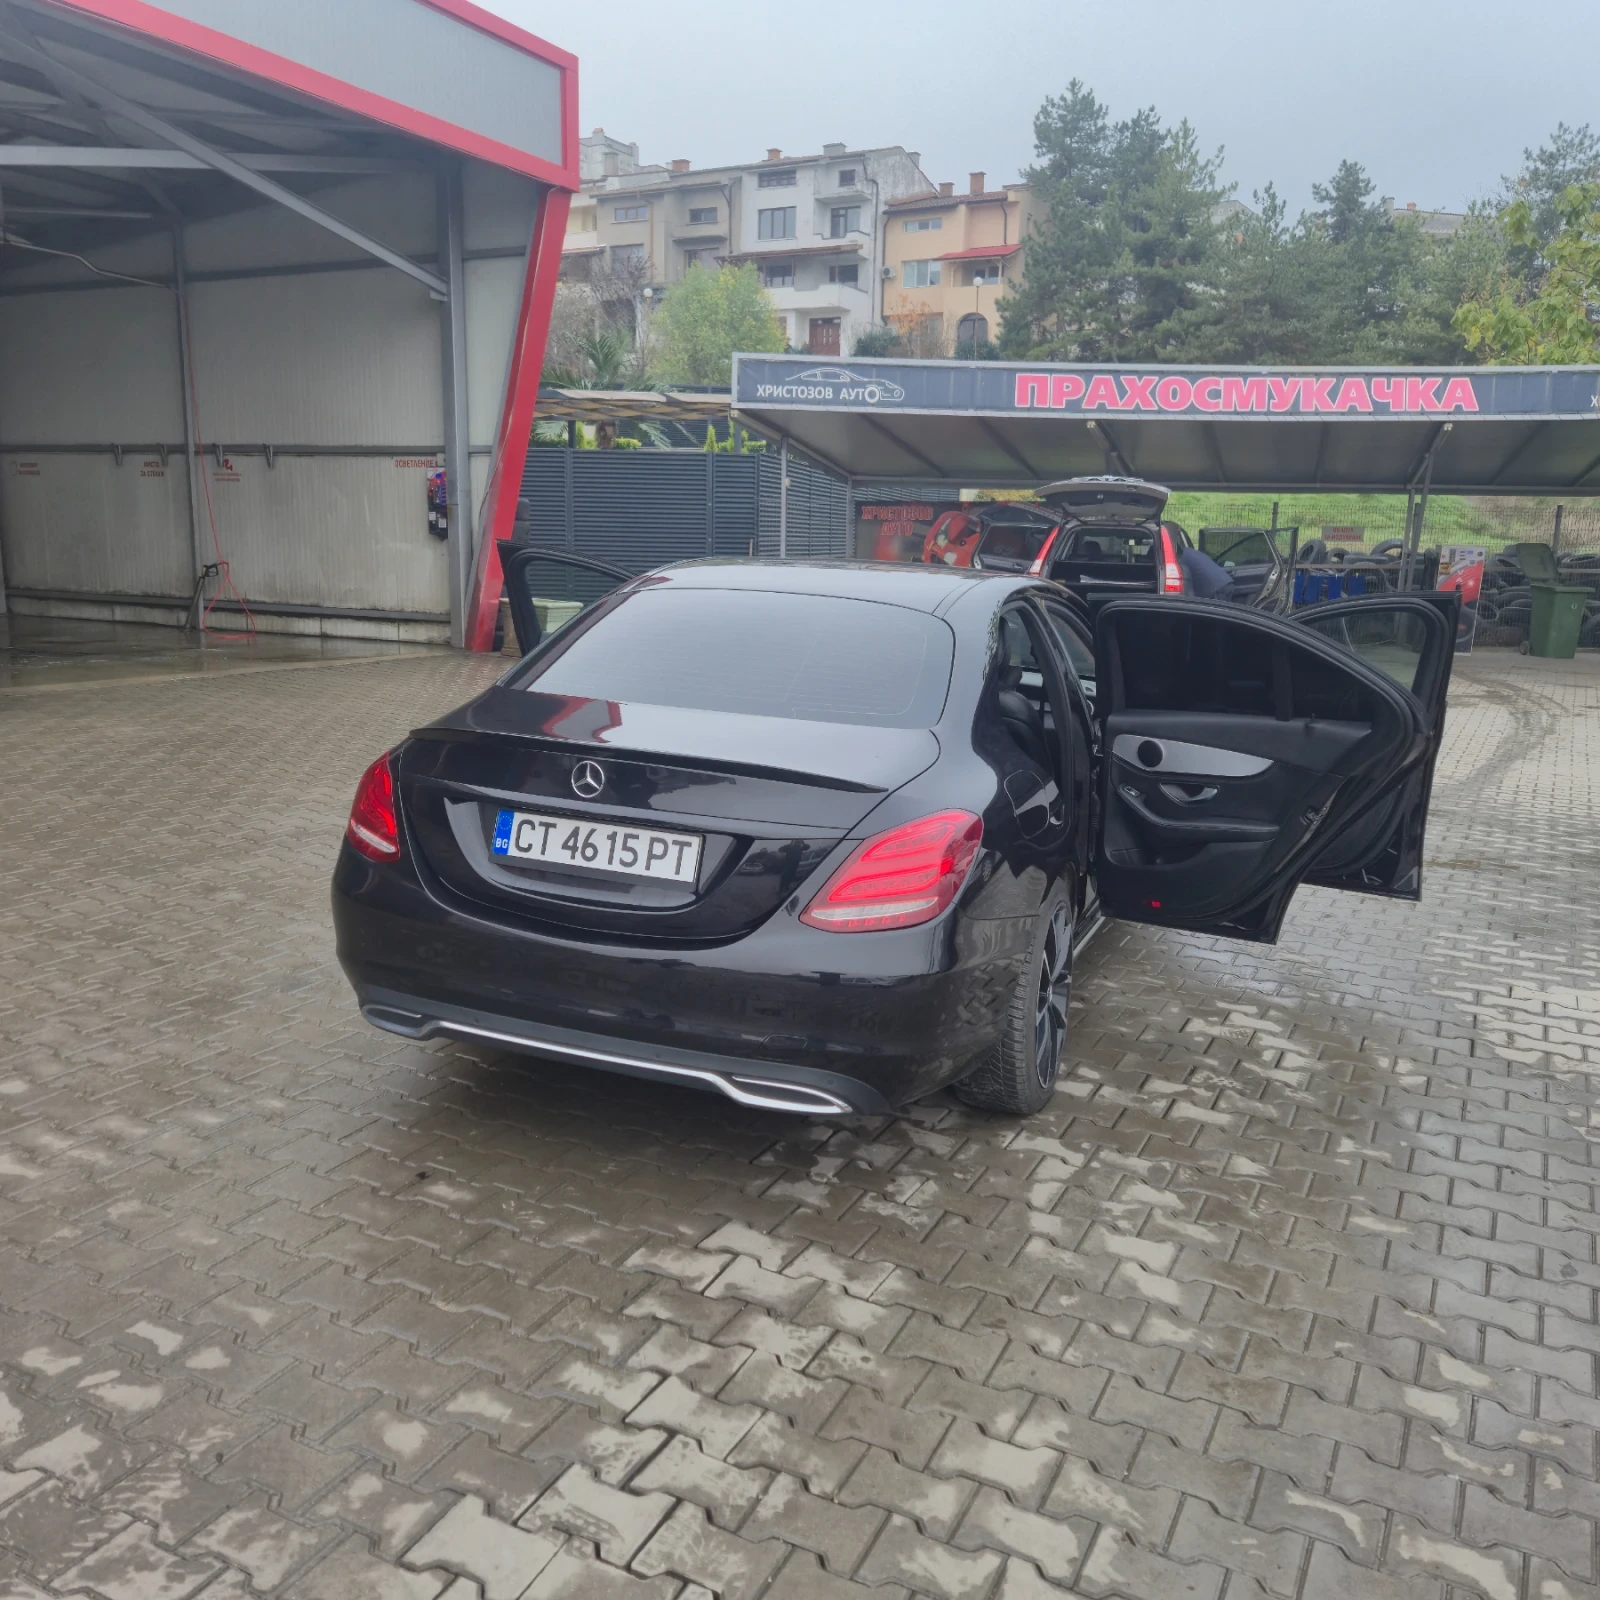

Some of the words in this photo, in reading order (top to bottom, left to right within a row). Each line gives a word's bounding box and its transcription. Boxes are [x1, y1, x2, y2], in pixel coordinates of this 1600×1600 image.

[756, 384, 833, 399] ХРИСТОЗОВ
[839, 386, 880, 403] АУТО
[1014, 373, 1479, 412] ПРАХОСМУКАЧКА
[395, 459, 433, 468] ОСВЕТЛЕНИЕ
[861, 505, 934, 520] ХРИСТОЗОВ
[881, 521, 913, 536] АУТО
[495, 837, 508, 849] BG
[514, 819, 557, 856] CT
[561, 826, 640, 868] 4615
[644, 836, 693, 876] PT
